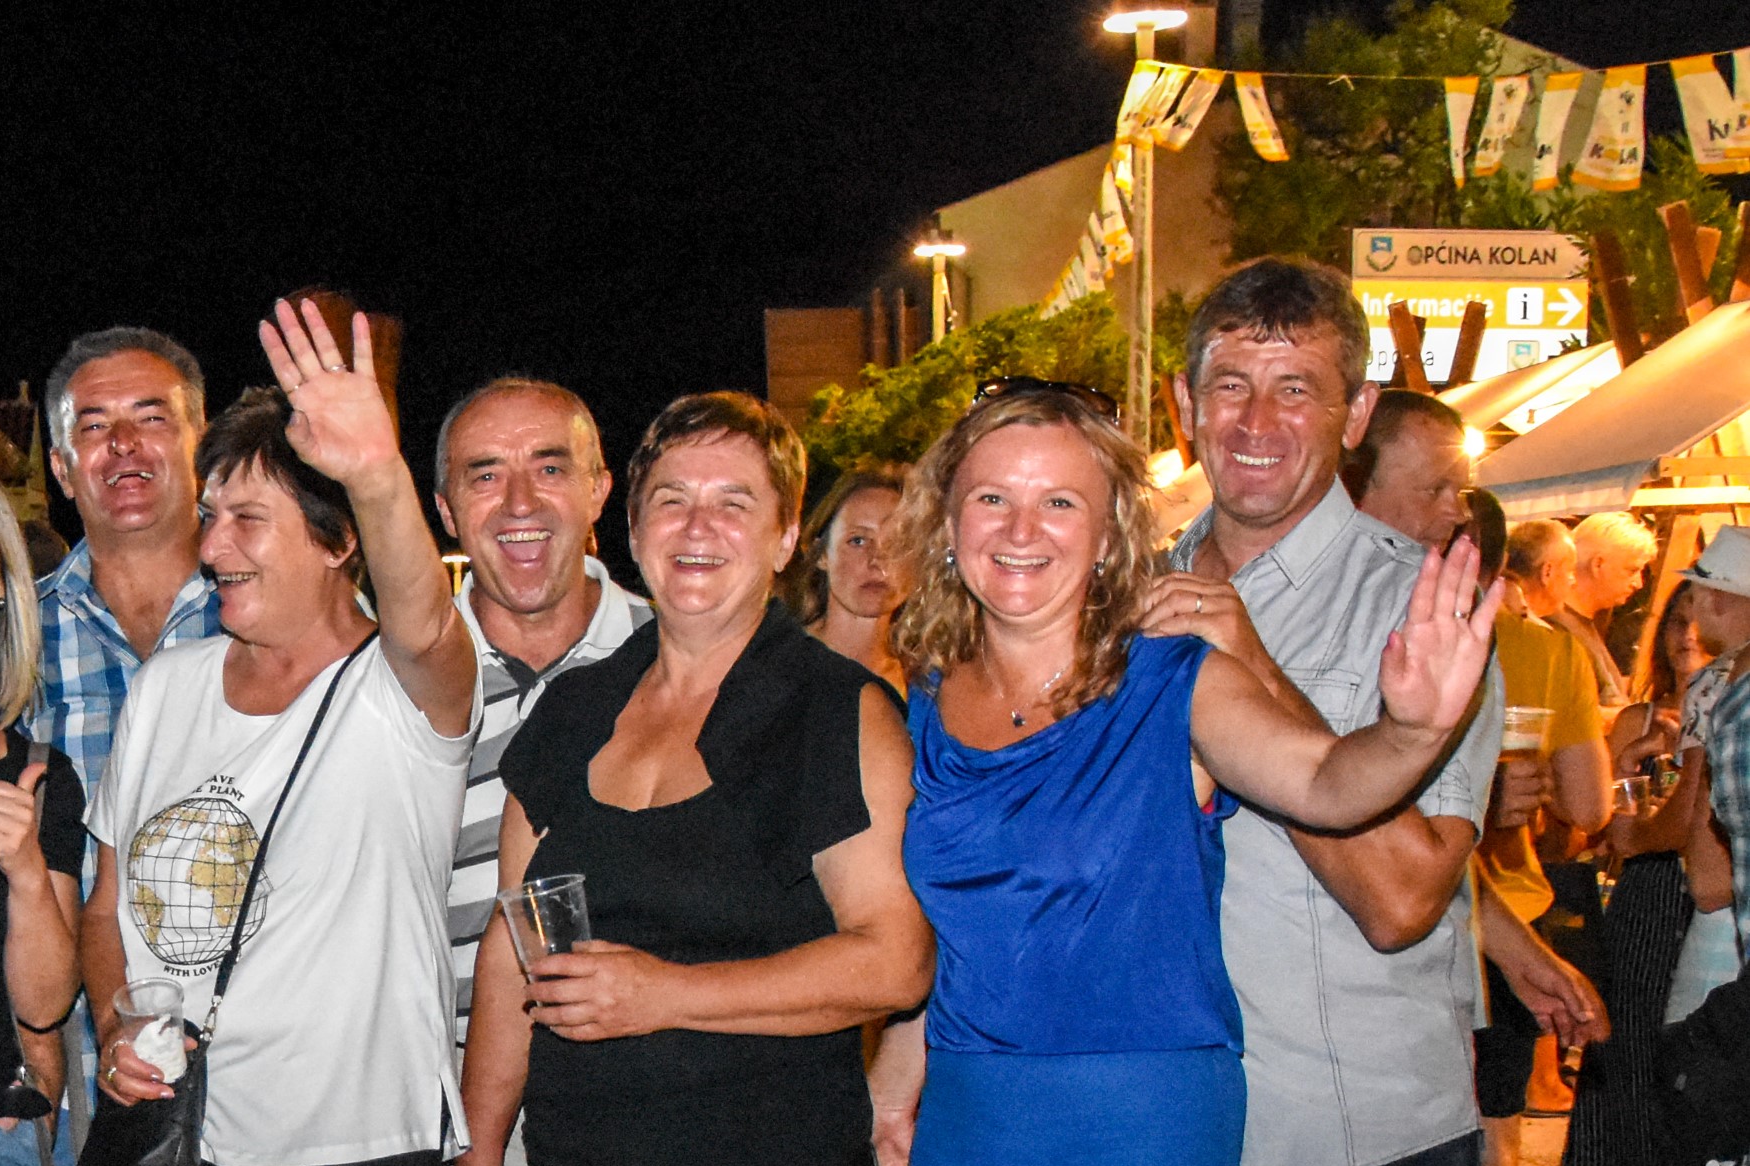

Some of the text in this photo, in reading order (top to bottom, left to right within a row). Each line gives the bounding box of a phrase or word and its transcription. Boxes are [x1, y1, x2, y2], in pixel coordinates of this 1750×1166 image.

[1407, 240, 1556, 266] OPĆINA KOLAN
[209, 784, 245, 802] PLANT
[163, 961, 220, 977] WITH LOVE
